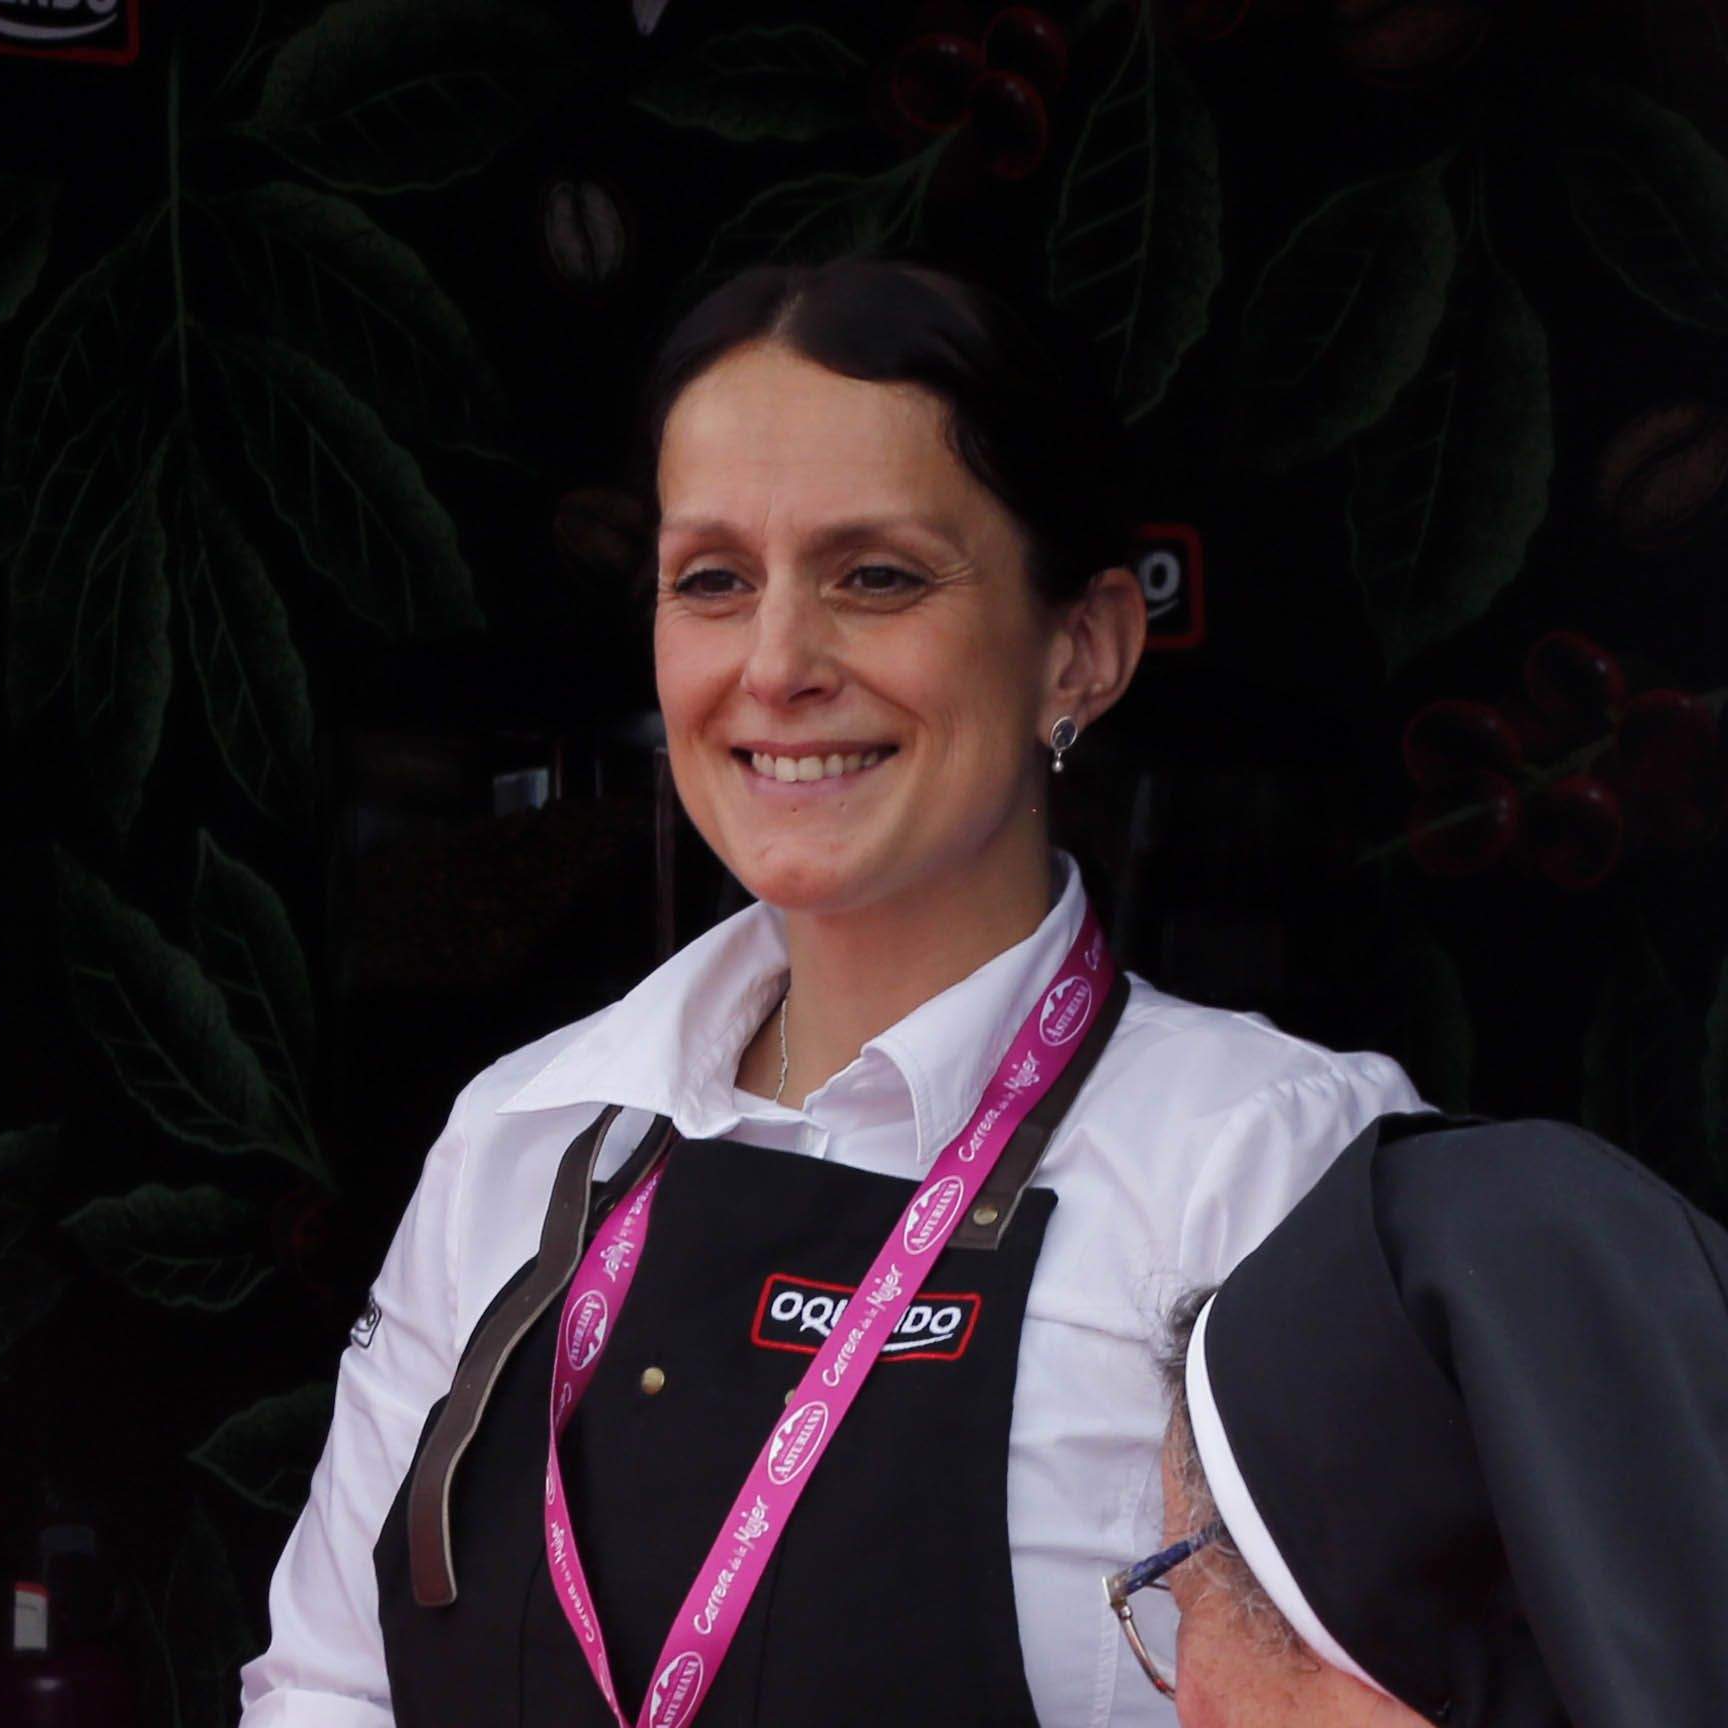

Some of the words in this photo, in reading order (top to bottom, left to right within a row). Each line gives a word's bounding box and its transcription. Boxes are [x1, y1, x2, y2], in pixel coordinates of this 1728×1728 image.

[958, 1108, 1001, 1162] Carrera
[770, 1291, 962, 1346] OQDO
[822, 1327, 865, 1387] Carrera
[694, 1568, 735, 1635] Carrera
[733, 1495, 769, 1549] Mujer
